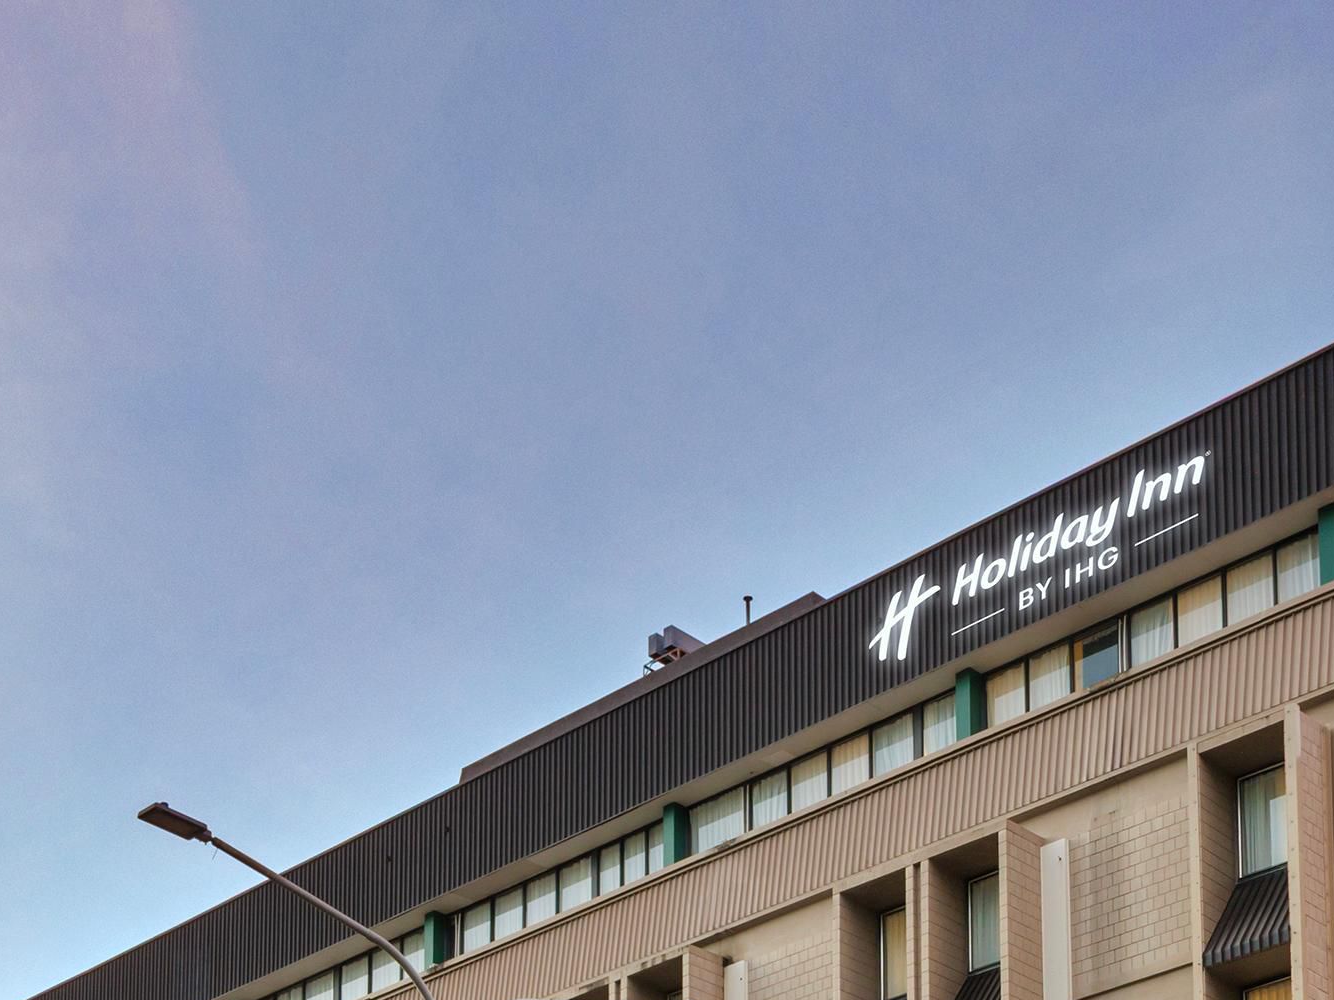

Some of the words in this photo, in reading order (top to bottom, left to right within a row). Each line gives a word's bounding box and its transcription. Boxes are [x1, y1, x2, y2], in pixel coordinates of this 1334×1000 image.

[951, 496, 1121, 606] Holiday
[1126, 453, 1206, 518] Inn
[1018, 575, 1053, 612] BY
[1063, 545, 1120, 590] IHG
